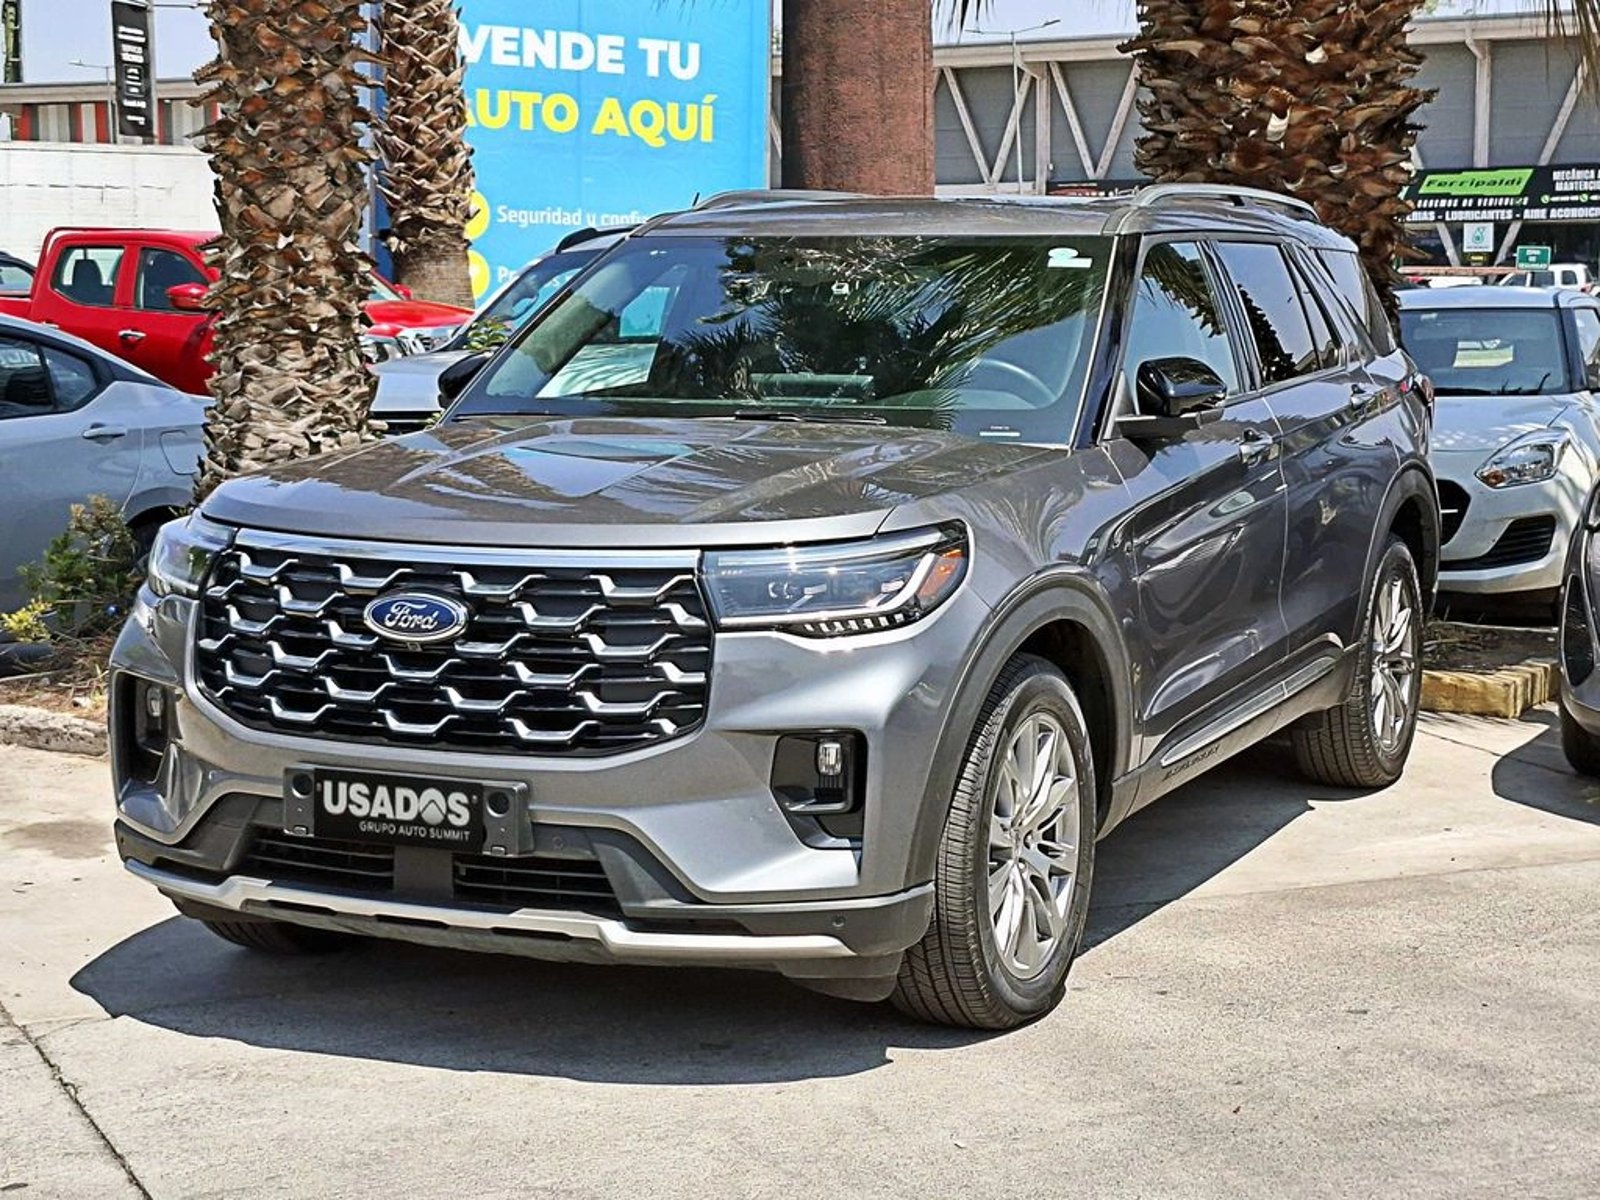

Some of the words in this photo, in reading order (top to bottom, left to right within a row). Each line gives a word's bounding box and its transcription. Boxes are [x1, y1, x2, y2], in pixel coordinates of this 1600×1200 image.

[457, 24, 625, 75] VENDE
[638, 38, 701, 81] TU
[591, 94, 719, 148] AQUÍ
[496, 204, 582, 227] Seguridad
[586, 212, 597, 227] y
[1445, 209, 1513, 221] LUBRICANTES
[384, 600, 440, 630] Ford
[322, 780, 470, 826] USADOS
[359, 819, 396, 835] GRUPO
[398, 823, 427, 838] AUTO
[429, 827, 470, 841] SUMMIT
